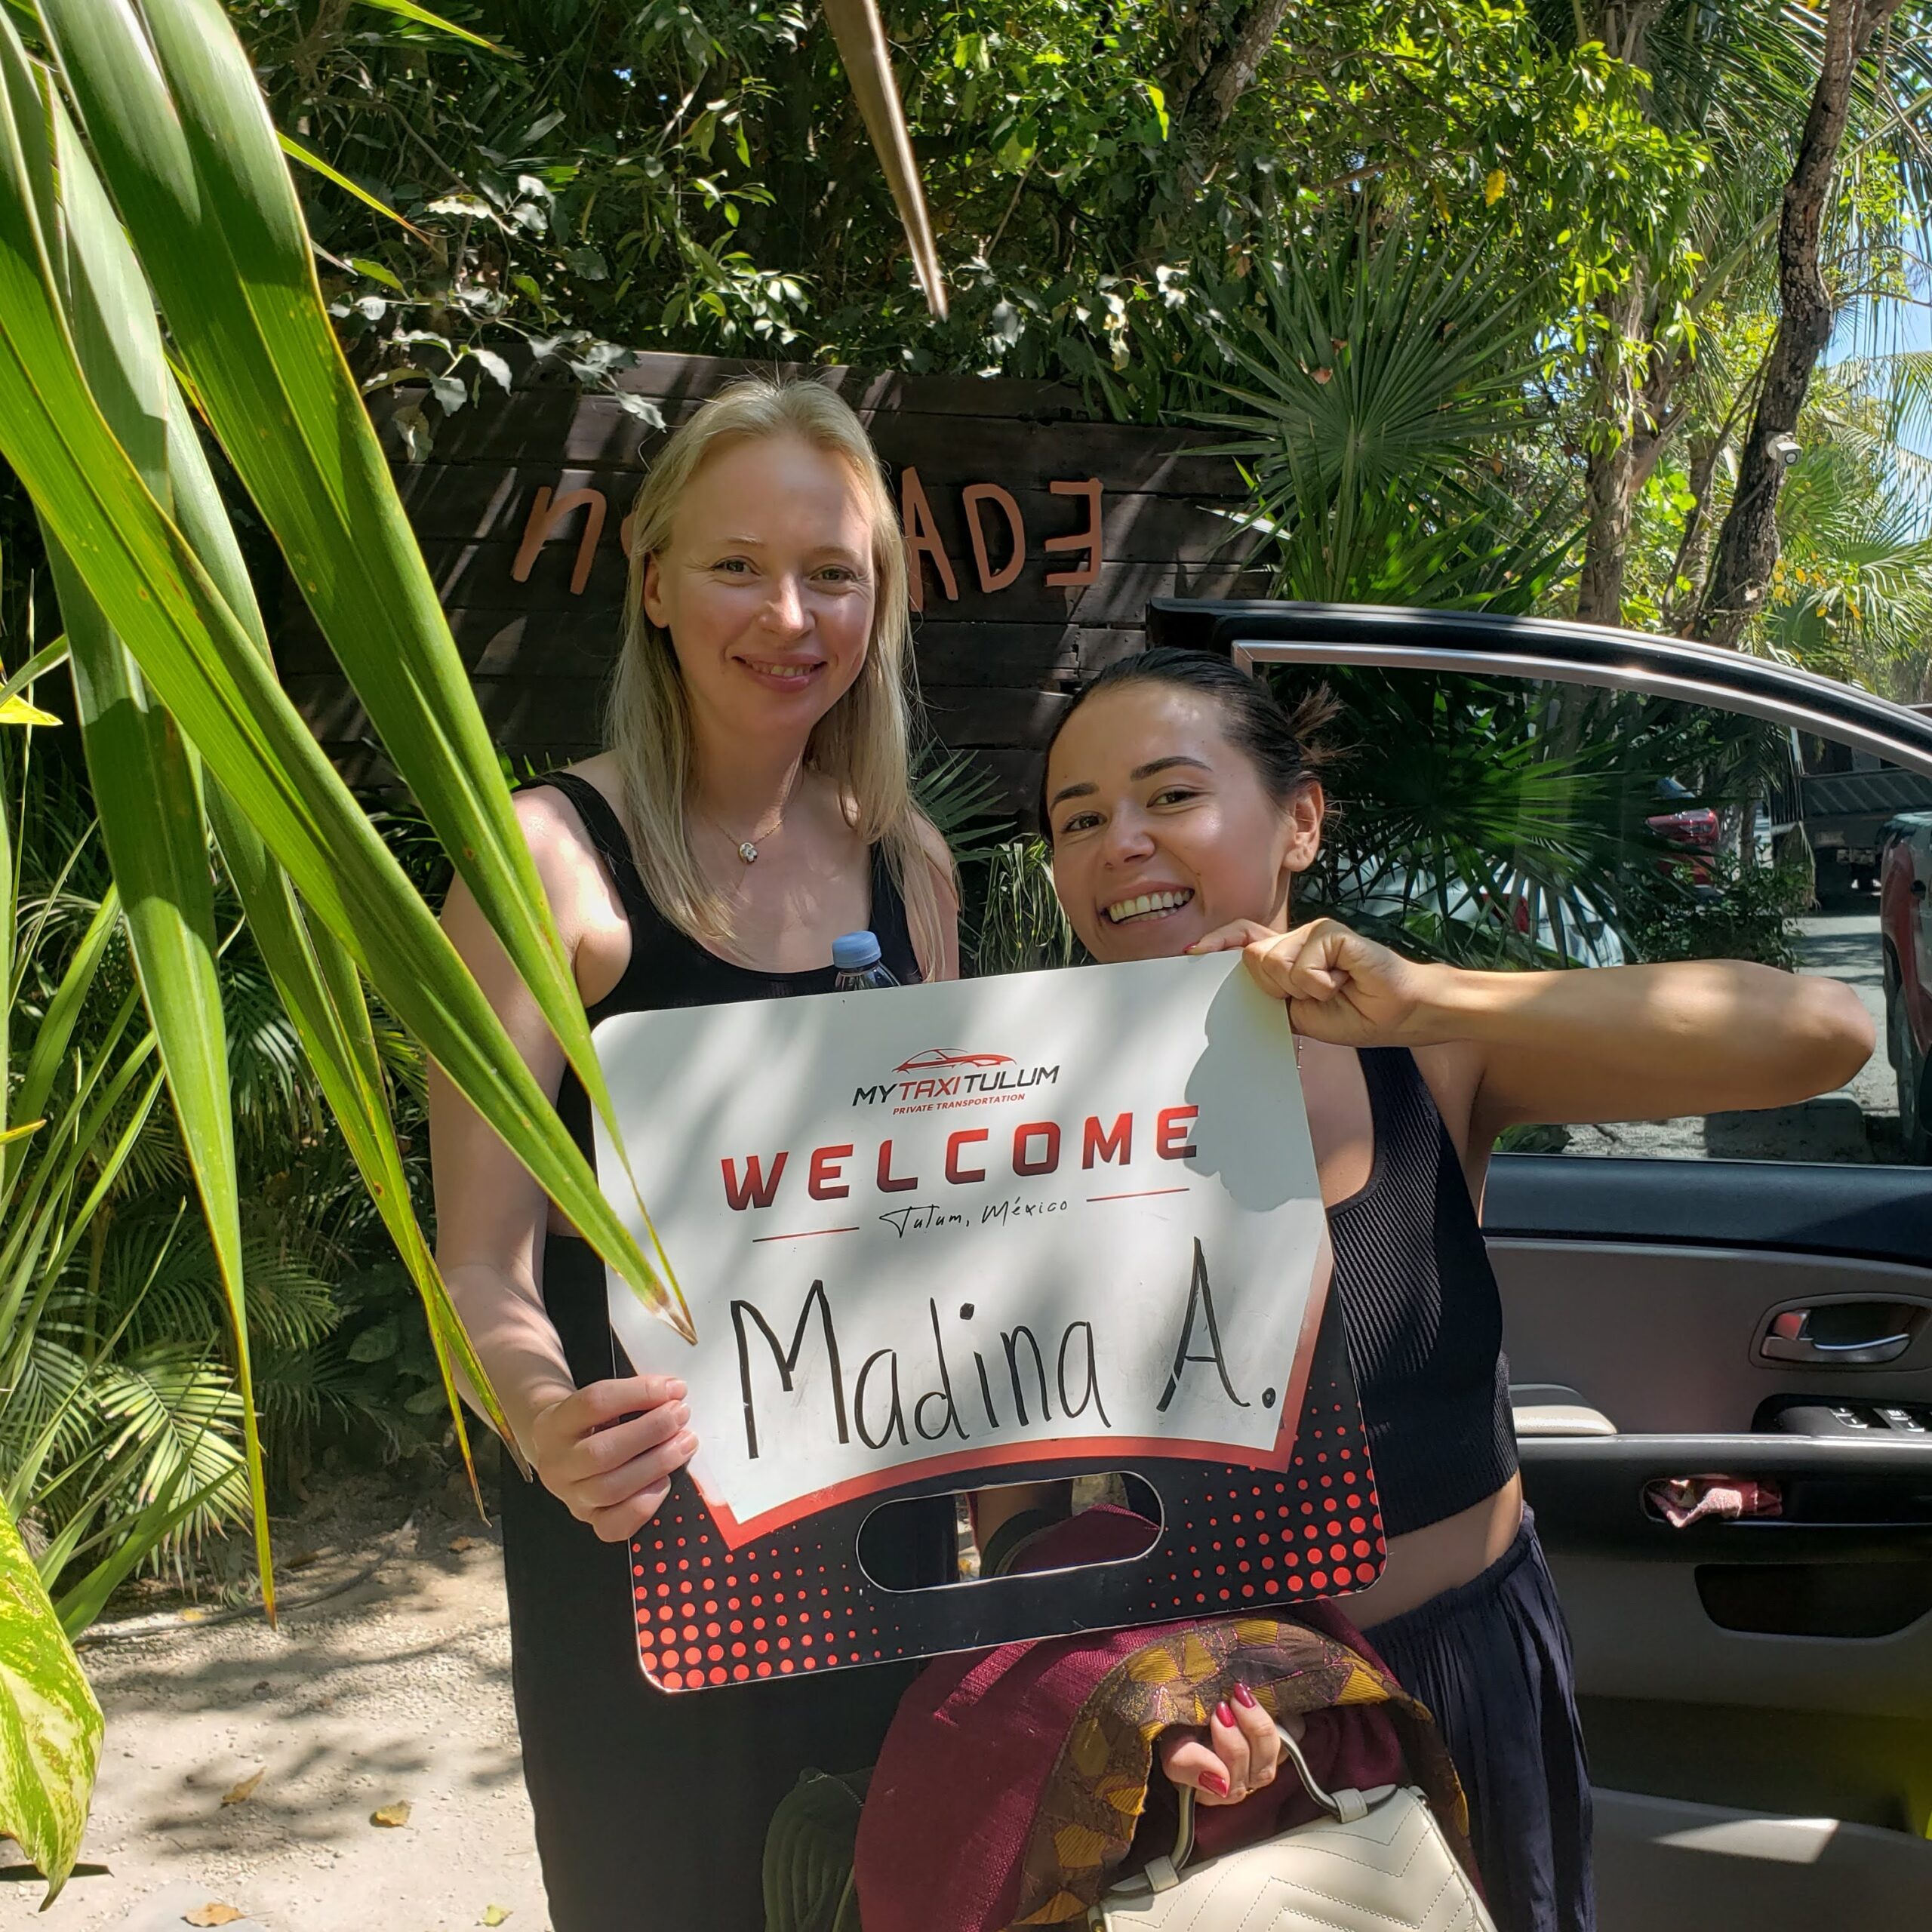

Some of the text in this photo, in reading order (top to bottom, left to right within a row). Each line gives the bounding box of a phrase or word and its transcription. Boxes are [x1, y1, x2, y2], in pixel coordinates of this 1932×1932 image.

[511, 466, 1103, 612] nADE
[721, 1104, 1199, 1211] WELCOME
[892, 1093, 1026, 1115] PRIVATE TRANSPORTATION
[878, 1196, 1068, 1238] Tulum, México
[730, 1235, 1277, 1459] Madina A.
